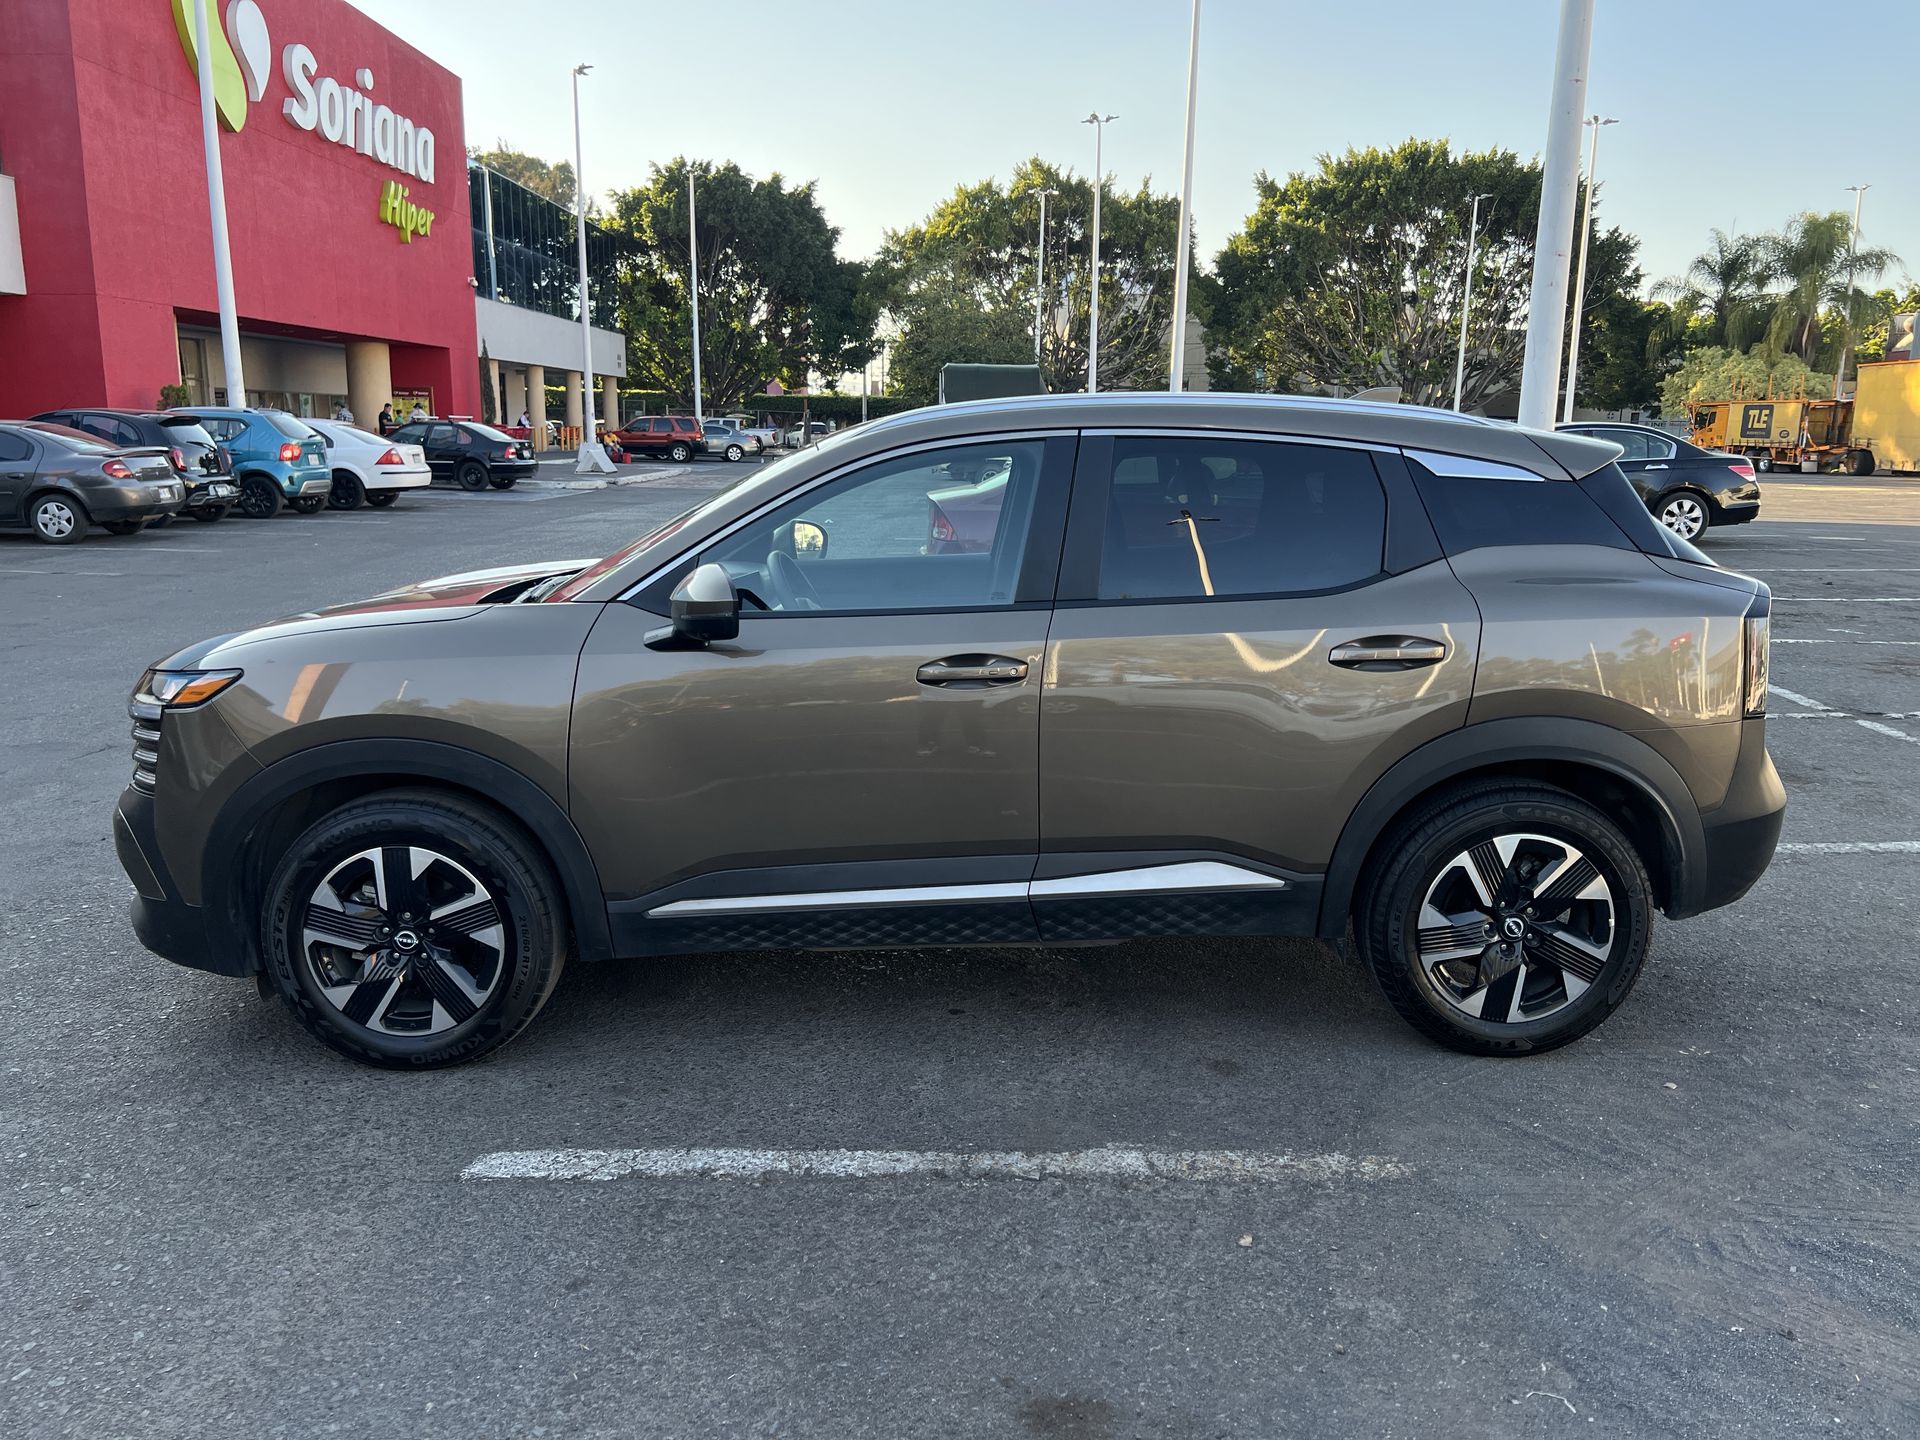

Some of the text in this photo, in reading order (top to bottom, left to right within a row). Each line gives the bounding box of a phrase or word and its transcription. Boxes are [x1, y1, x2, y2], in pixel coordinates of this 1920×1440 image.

[282, 43, 435, 184] Soriana
[379, 180, 435, 243] Hiper
[1748, 409, 1770, 429] TLE
[520, 955, 530, 977] R17
[410, 1033, 486, 1064] KUMHO
